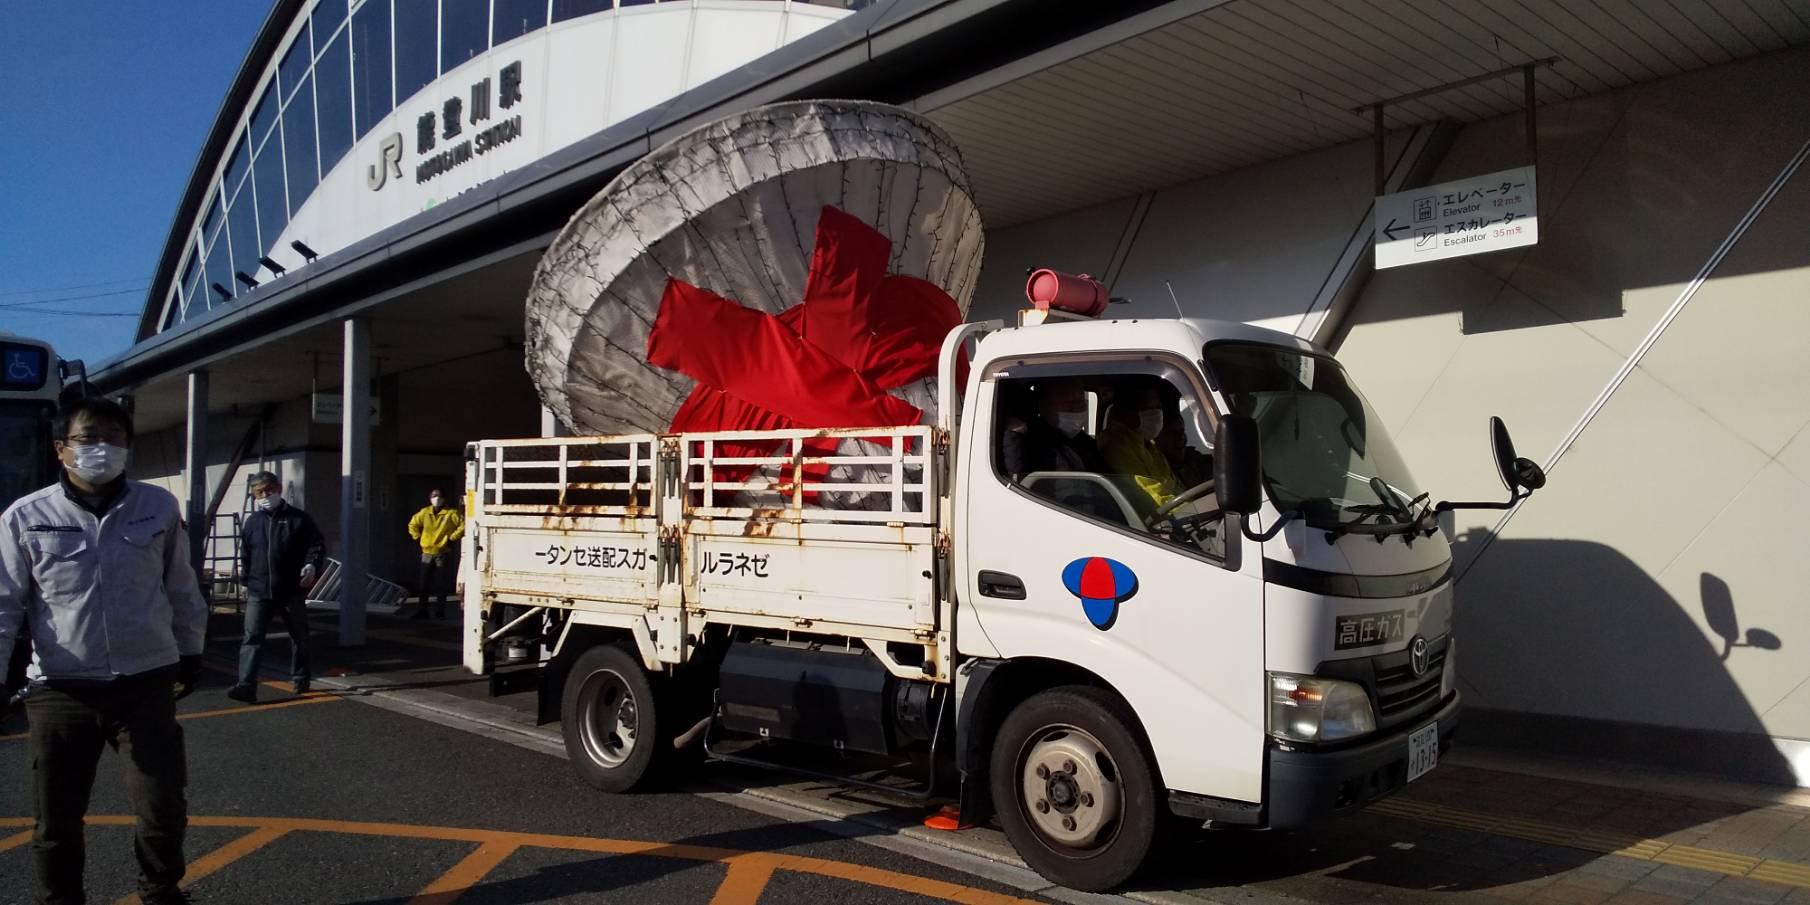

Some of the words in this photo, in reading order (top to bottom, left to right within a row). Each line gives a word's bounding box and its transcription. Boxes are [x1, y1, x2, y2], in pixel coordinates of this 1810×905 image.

[474, 114, 522, 156] STATION
[367, 131, 403, 192] JR
[1443, 182, 1526, 206] エレベーター
[1442, 202, 1481, 218] Elevator
[1443, 212, 1528, 235] エスカレーター
[1443, 232, 1487, 247] Escalator
[1339, 613, 1402, 645] 高圧ガス
